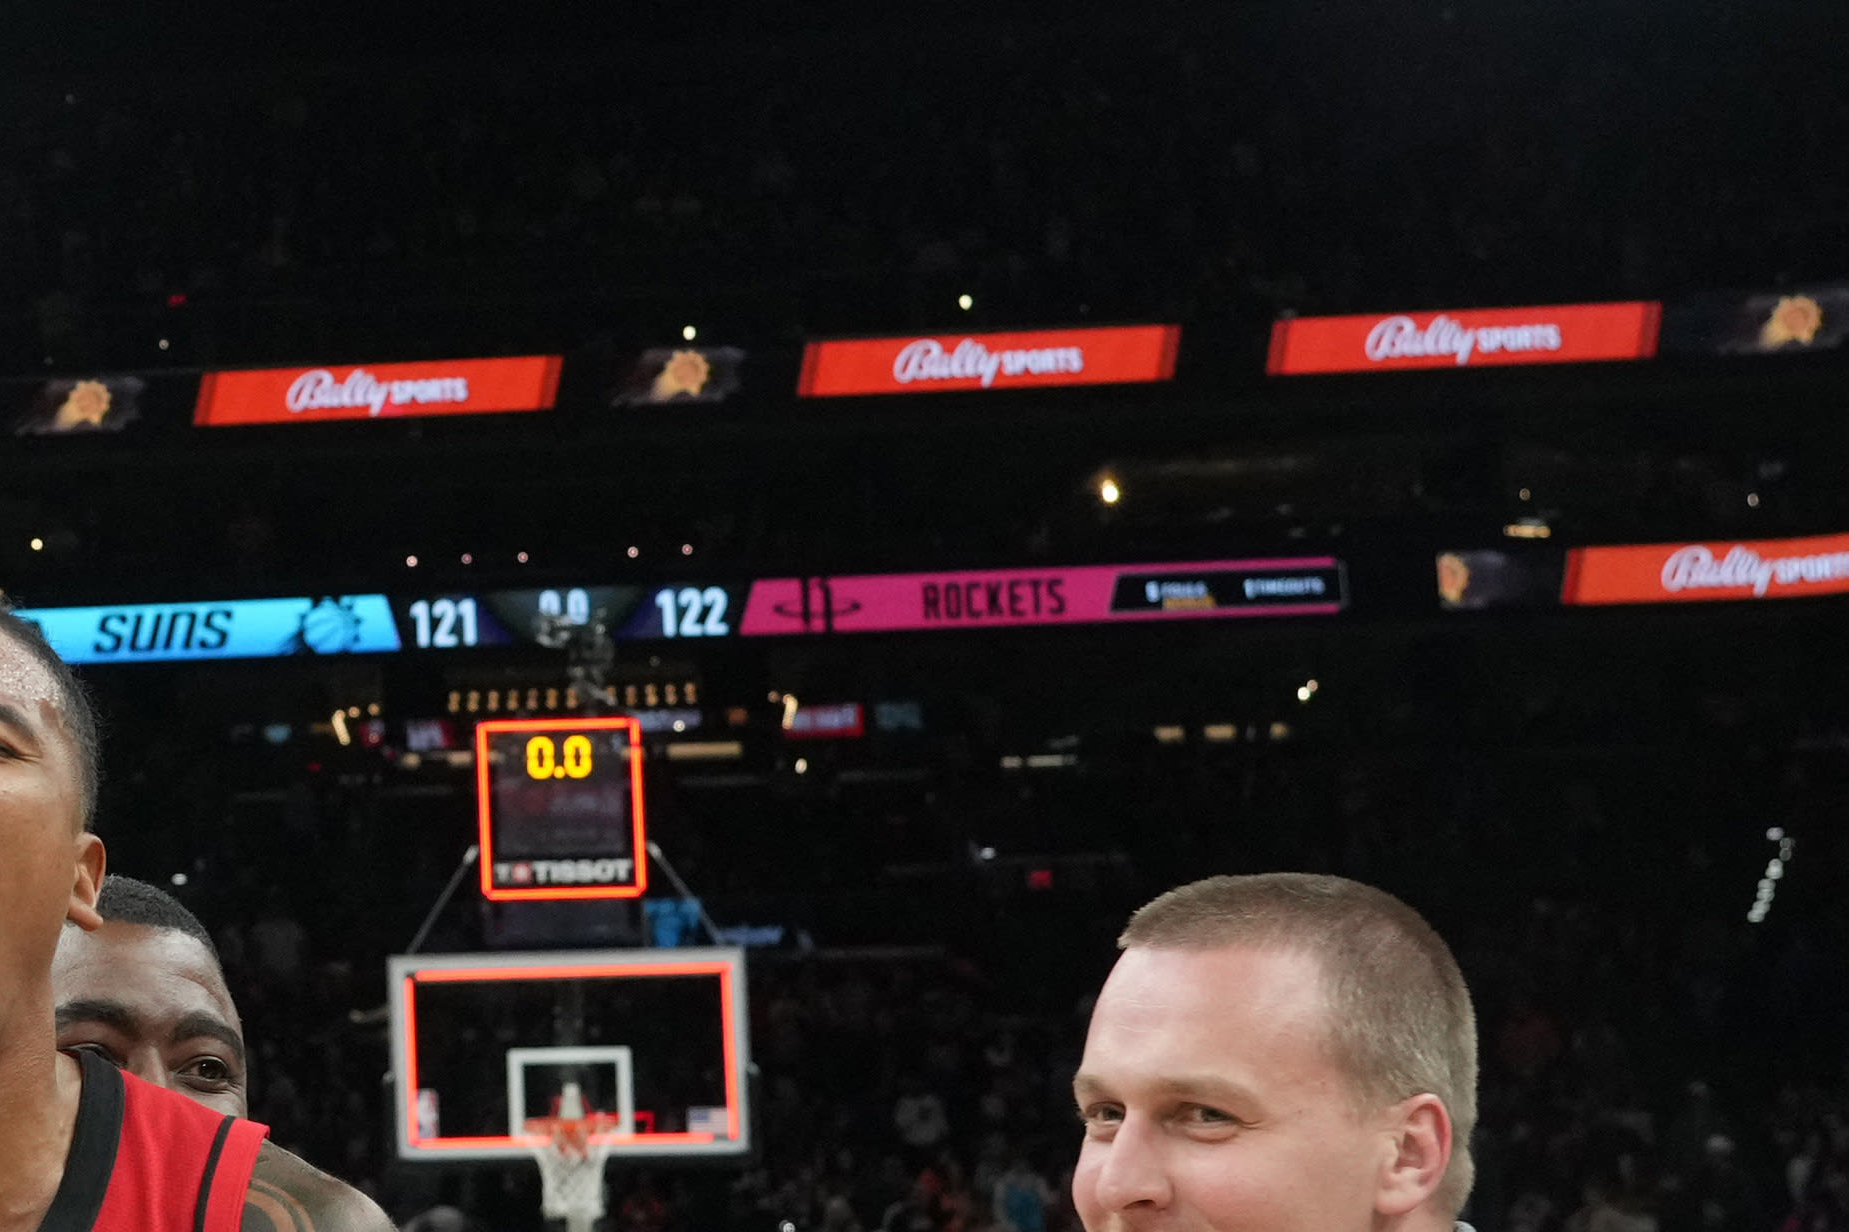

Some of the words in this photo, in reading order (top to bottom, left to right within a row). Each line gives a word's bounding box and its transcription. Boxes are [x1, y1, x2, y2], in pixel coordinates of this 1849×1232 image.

[892, 338, 1001, 387] Bally
[1001, 346, 1085, 376] SPORTS
[1364, 314, 1476, 365] Bally
[1476, 323, 1562, 354] SPORTS
[285, 368, 390, 417] Bally
[390, 376, 470, 406] SPORTS
[1660, 545, 1774, 596] Bally
[410, 598, 478, 648] 121
[655, 586, 729, 638] 122
[923, 578, 1066, 621] ROCKETS
[526, 735, 593, 780] 0.0
[533, 859, 632, 884] TISSOT
